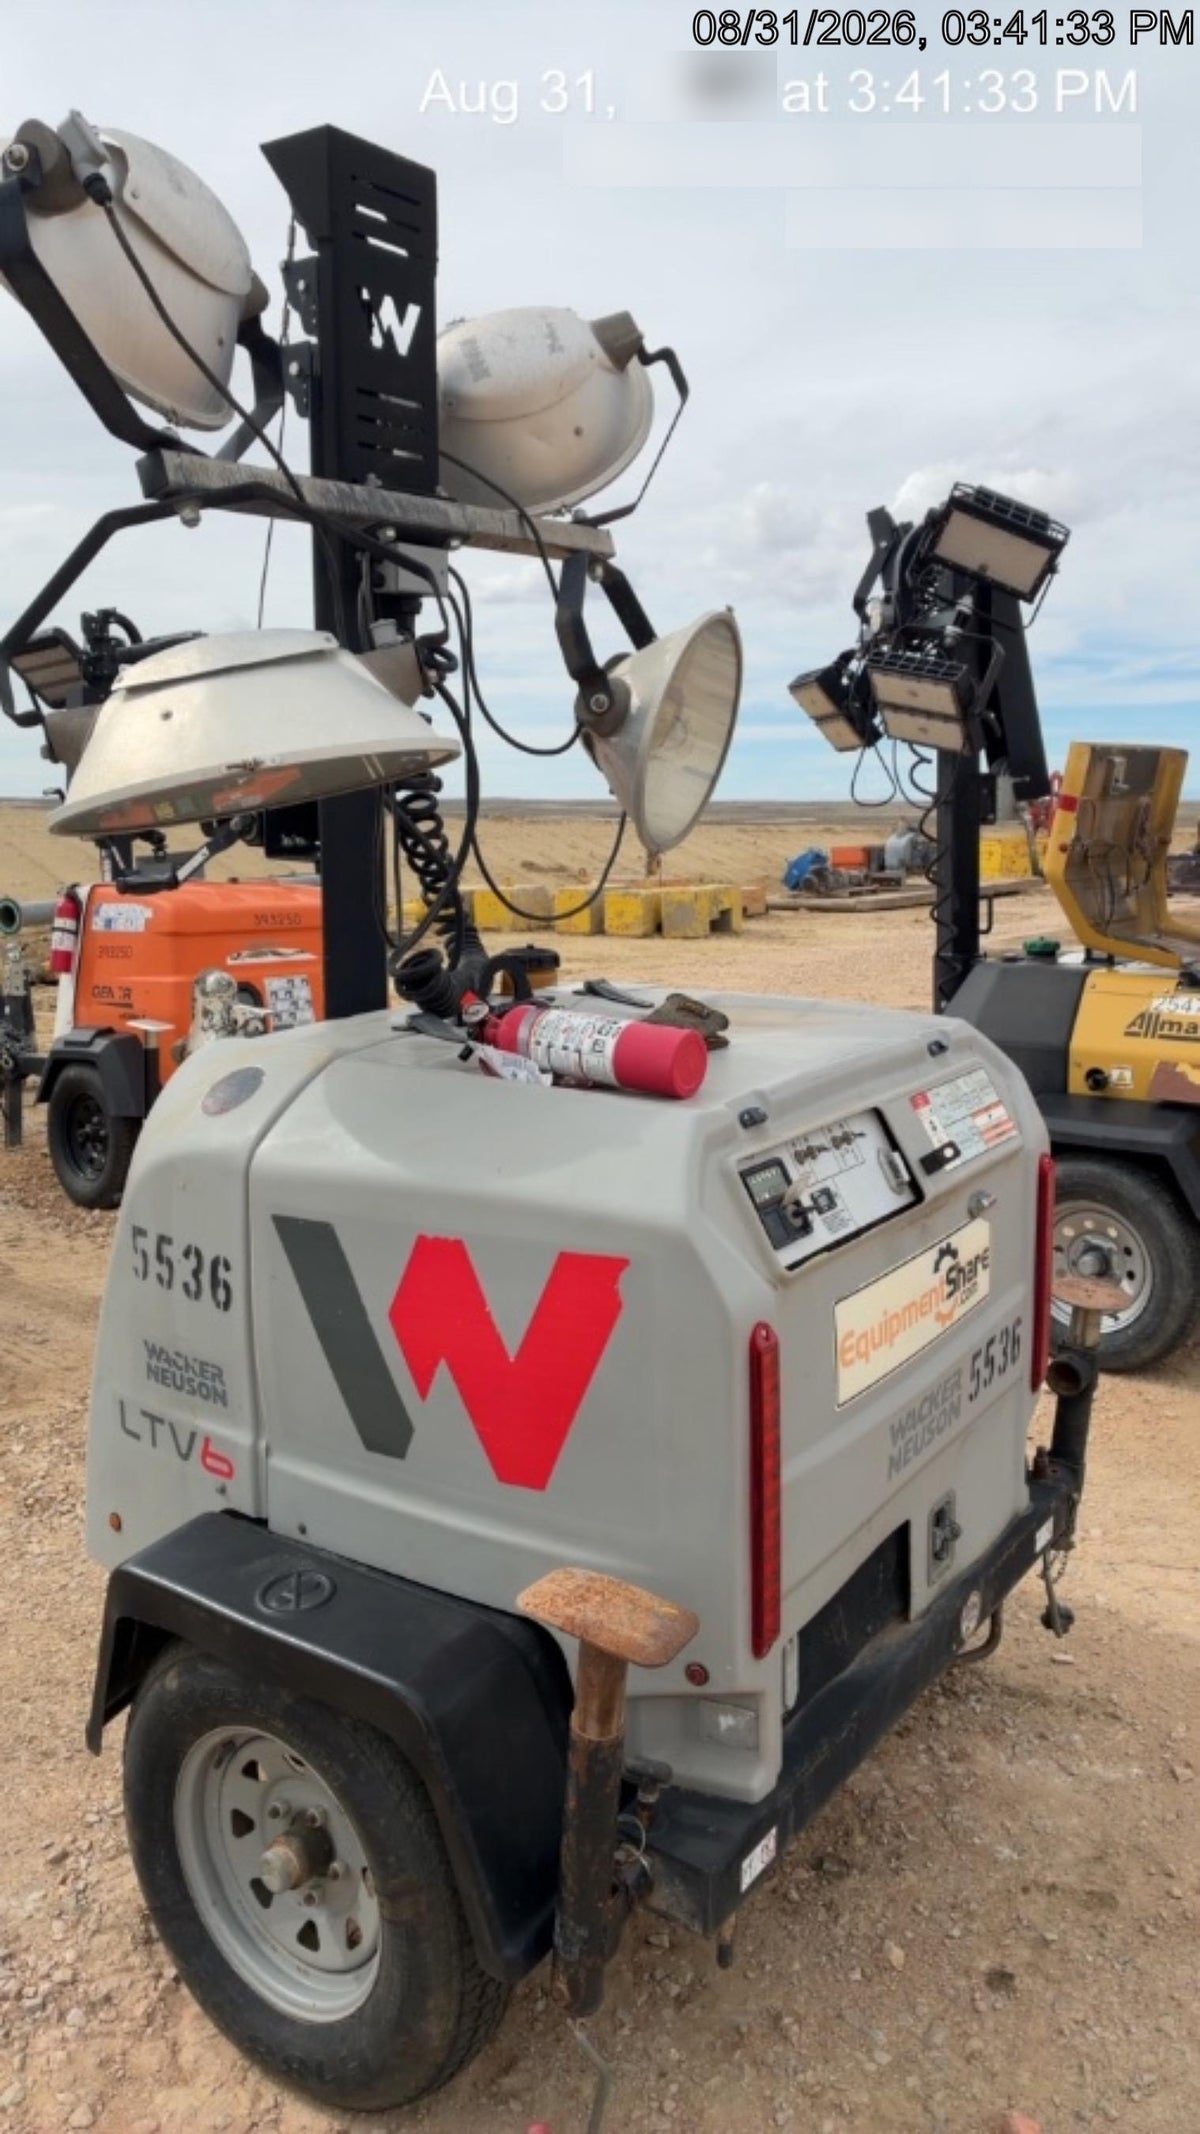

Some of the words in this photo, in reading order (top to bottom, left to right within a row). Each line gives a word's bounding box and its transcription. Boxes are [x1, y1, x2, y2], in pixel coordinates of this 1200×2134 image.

[131, 1224, 233, 1312] 5536
[142, 1338, 227, 1388] WACKER
[146, 1360, 228, 1409] NEUSON
[968, 1316, 1023, 1403] 5536
[888, 1398, 961, 1482] NEUSON
[889, 1366, 964, 1447] WACKER
